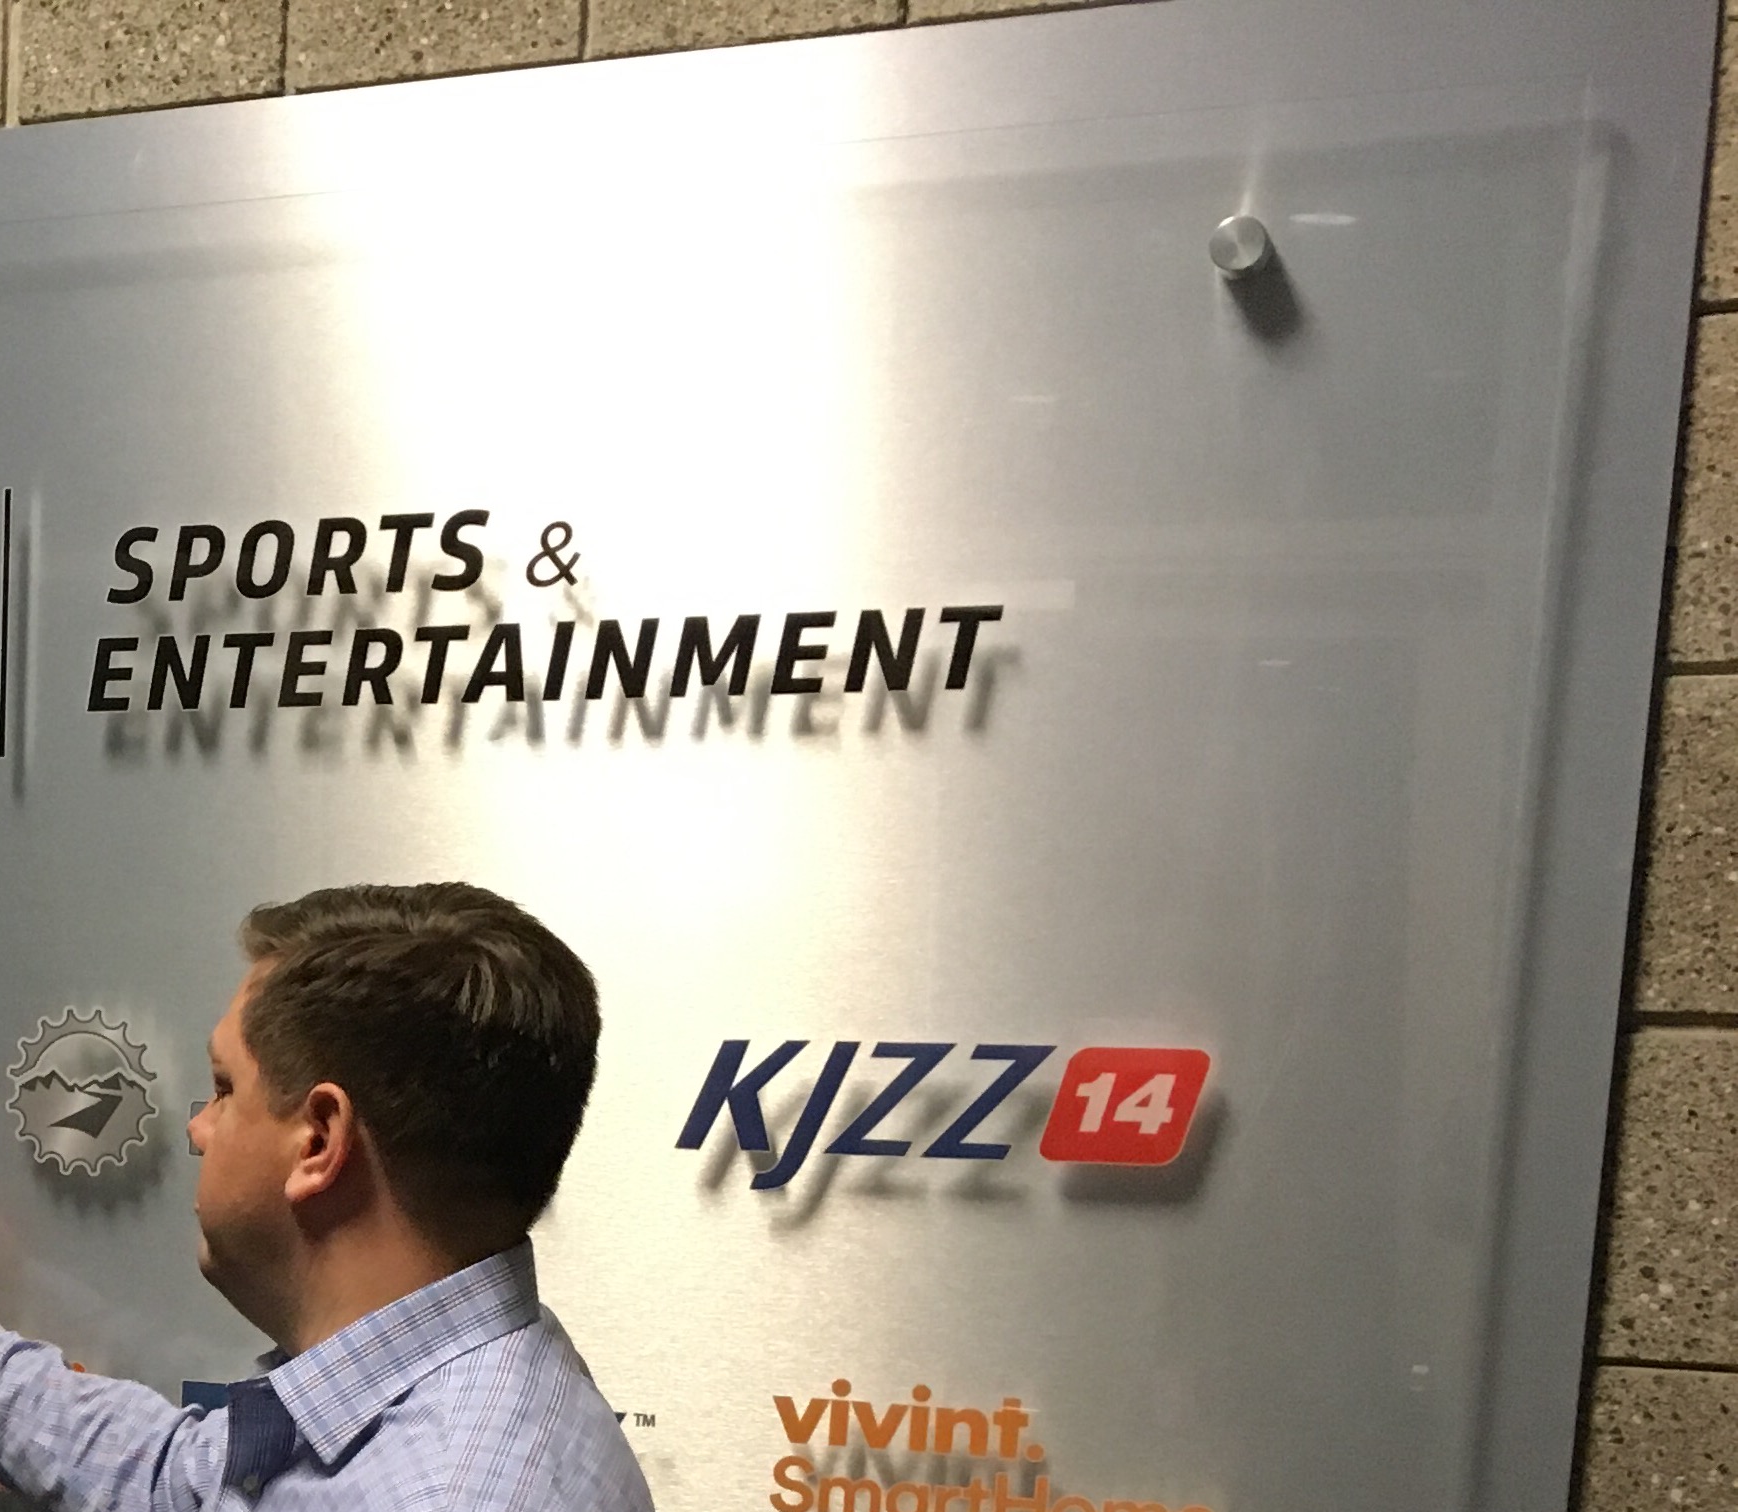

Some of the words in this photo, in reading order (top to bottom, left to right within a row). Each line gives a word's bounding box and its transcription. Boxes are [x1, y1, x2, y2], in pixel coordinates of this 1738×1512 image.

[106, 508, 490, 605] SPORTS
[524, 520, 582, 588] &
[86, 604, 1003, 713] ENTERTAINMENT
[674, 1039, 1058, 1191] KJZZ
[1074, 1071, 1178, 1136] 14
[632, 1412, 657, 1428] TM
[771, 1377, 1046, 1462] vivint.
